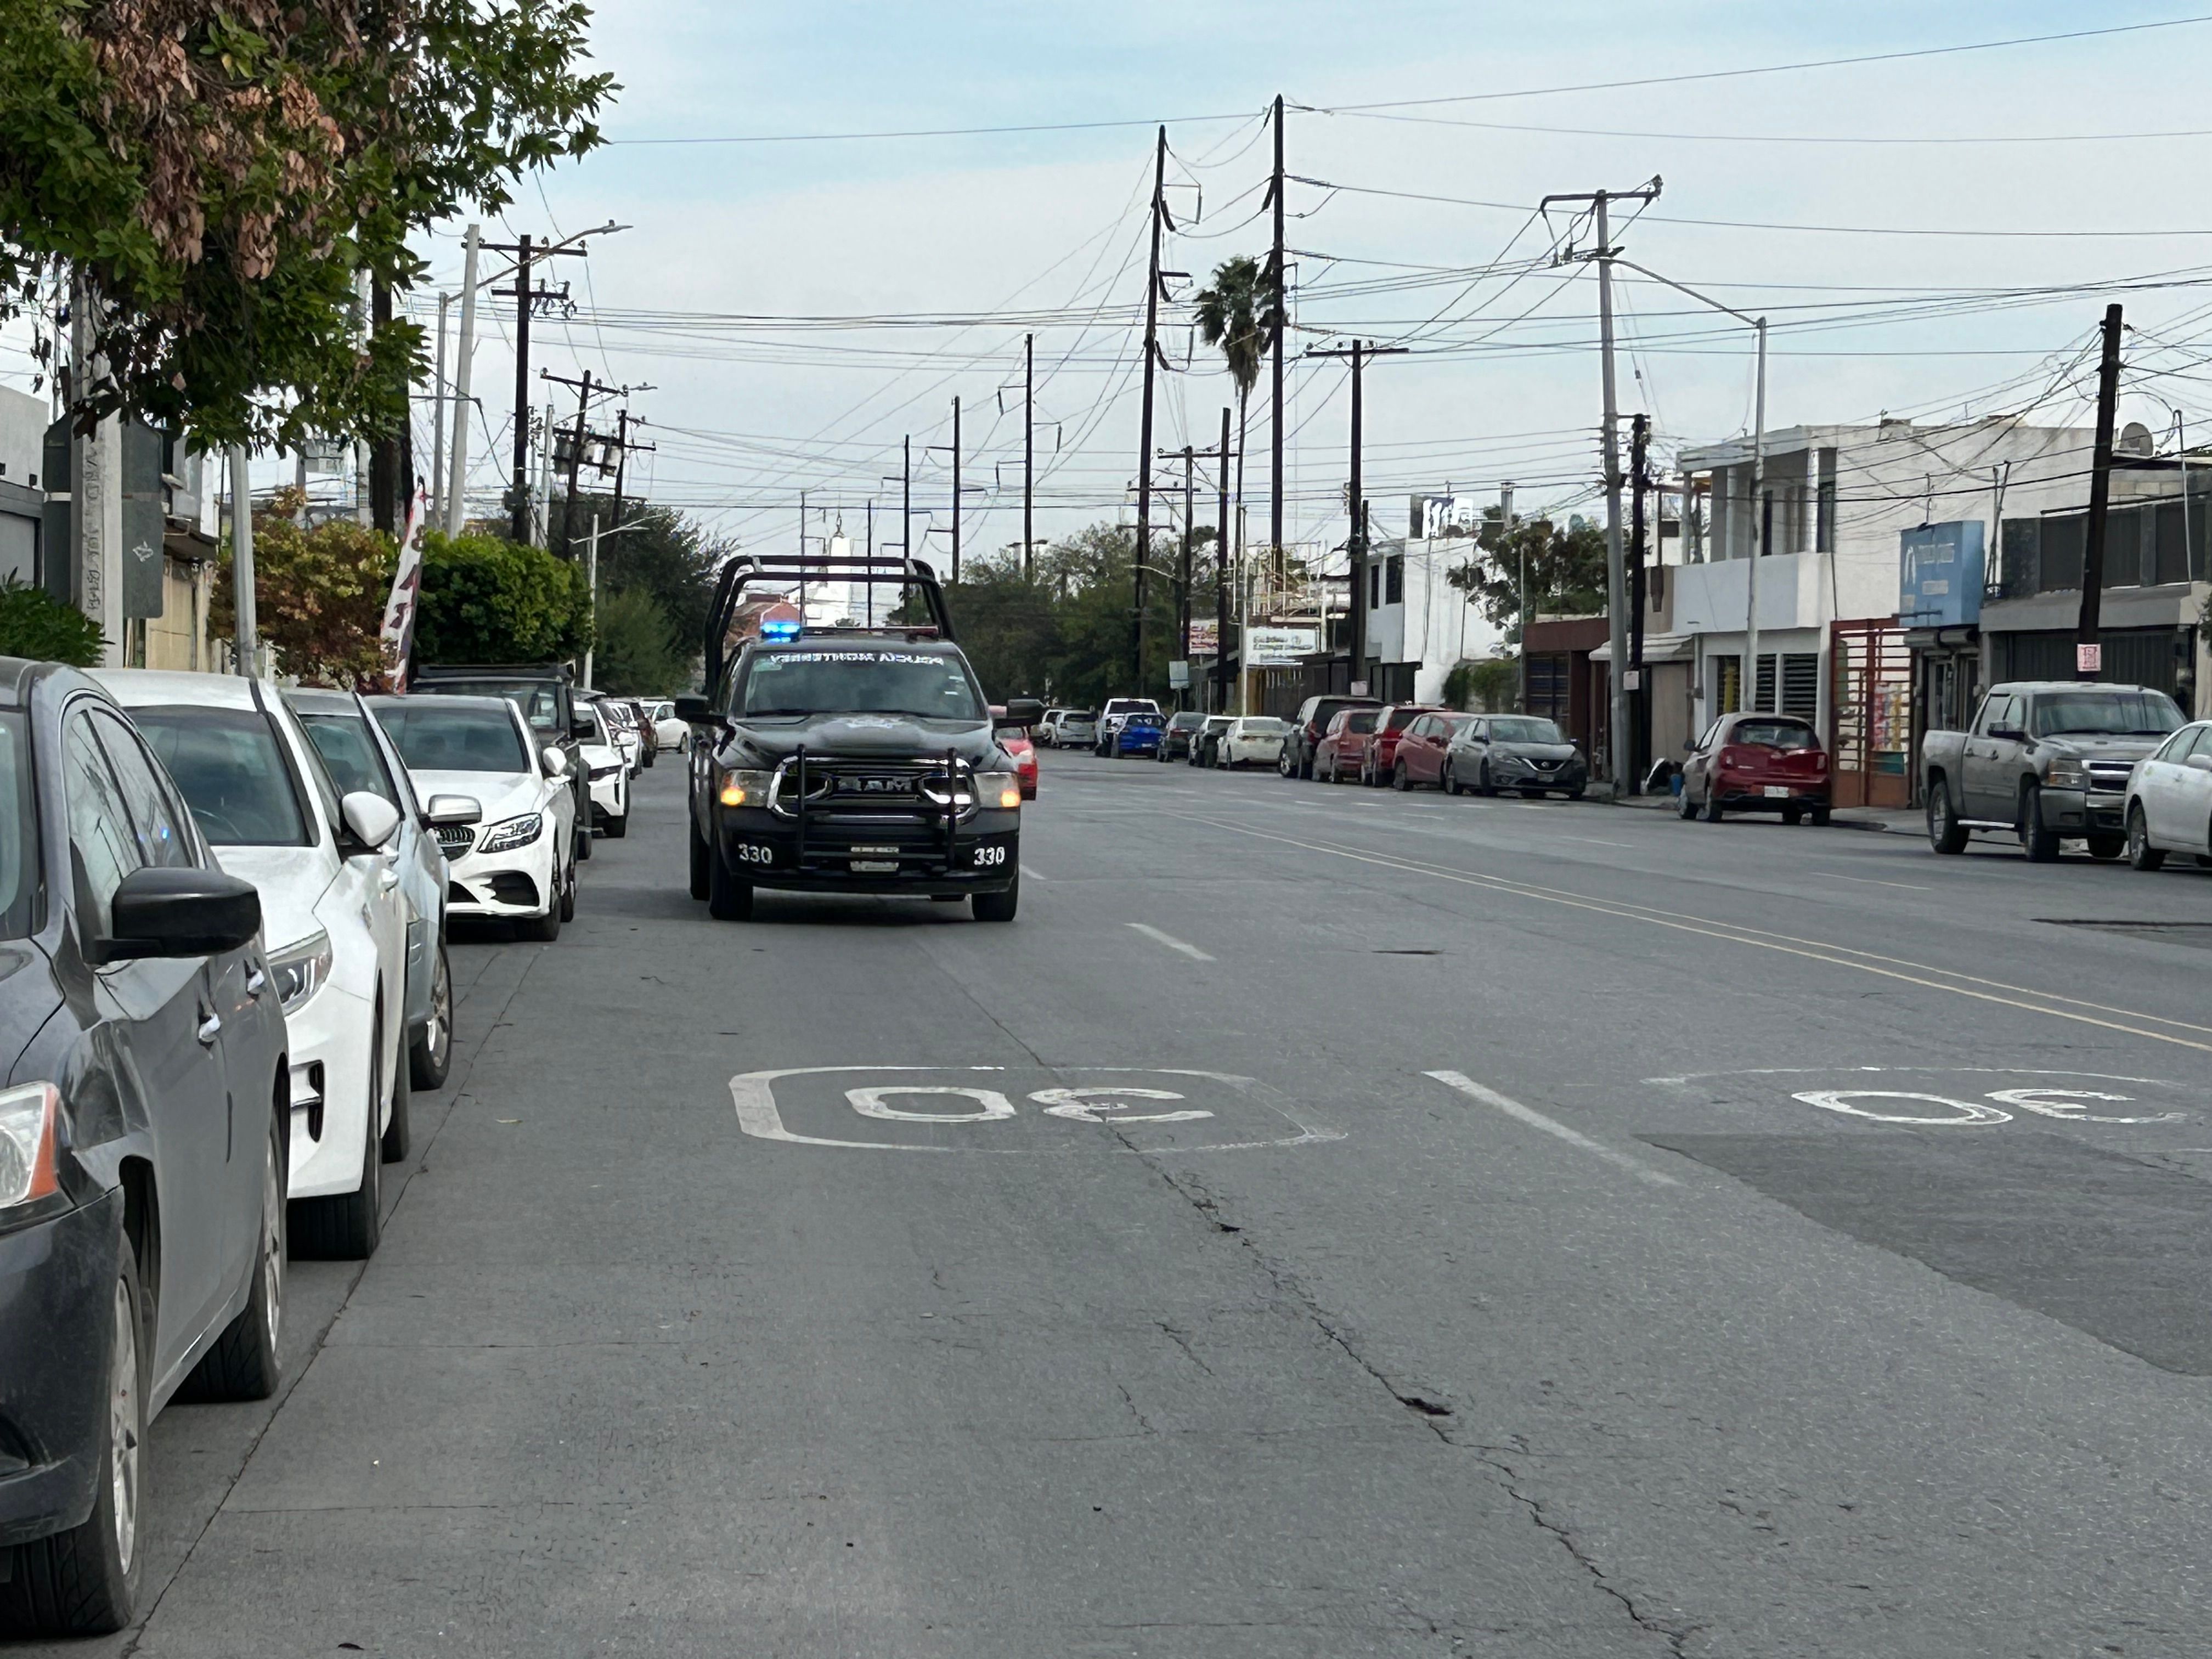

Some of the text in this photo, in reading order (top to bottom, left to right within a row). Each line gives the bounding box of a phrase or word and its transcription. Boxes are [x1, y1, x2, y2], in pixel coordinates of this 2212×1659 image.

[738, 843, 772, 864] 330
[974, 847, 1005, 865] 330
[844, 1086, 1214, 1122] 30
[1791, 1088, 2188, 1126] 30
